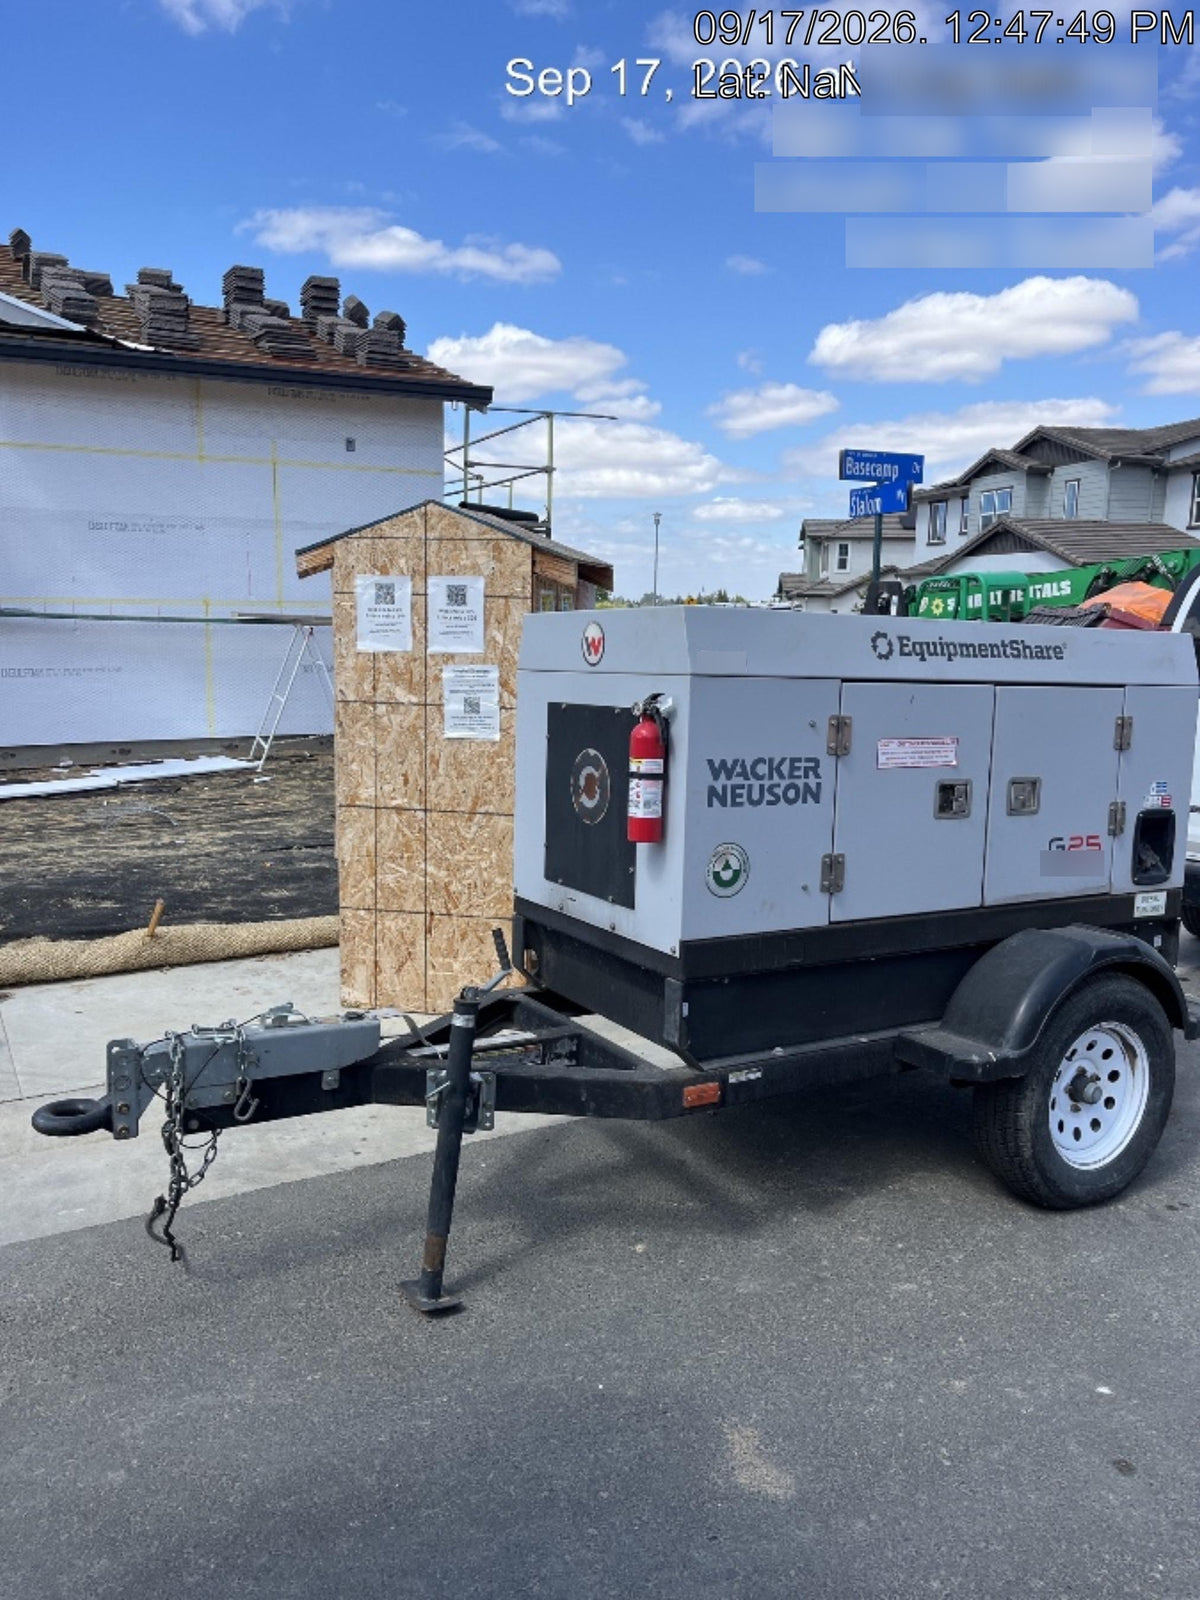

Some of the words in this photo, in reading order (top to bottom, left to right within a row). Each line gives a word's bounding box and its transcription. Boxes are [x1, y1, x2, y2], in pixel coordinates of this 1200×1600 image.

[845, 457, 899, 481] Basecamp
[897, 636, 1065, 661] EquipmentShare
[706, 757, 822, 780] WACKER
[707, 782, 822, 808] NEUSON
